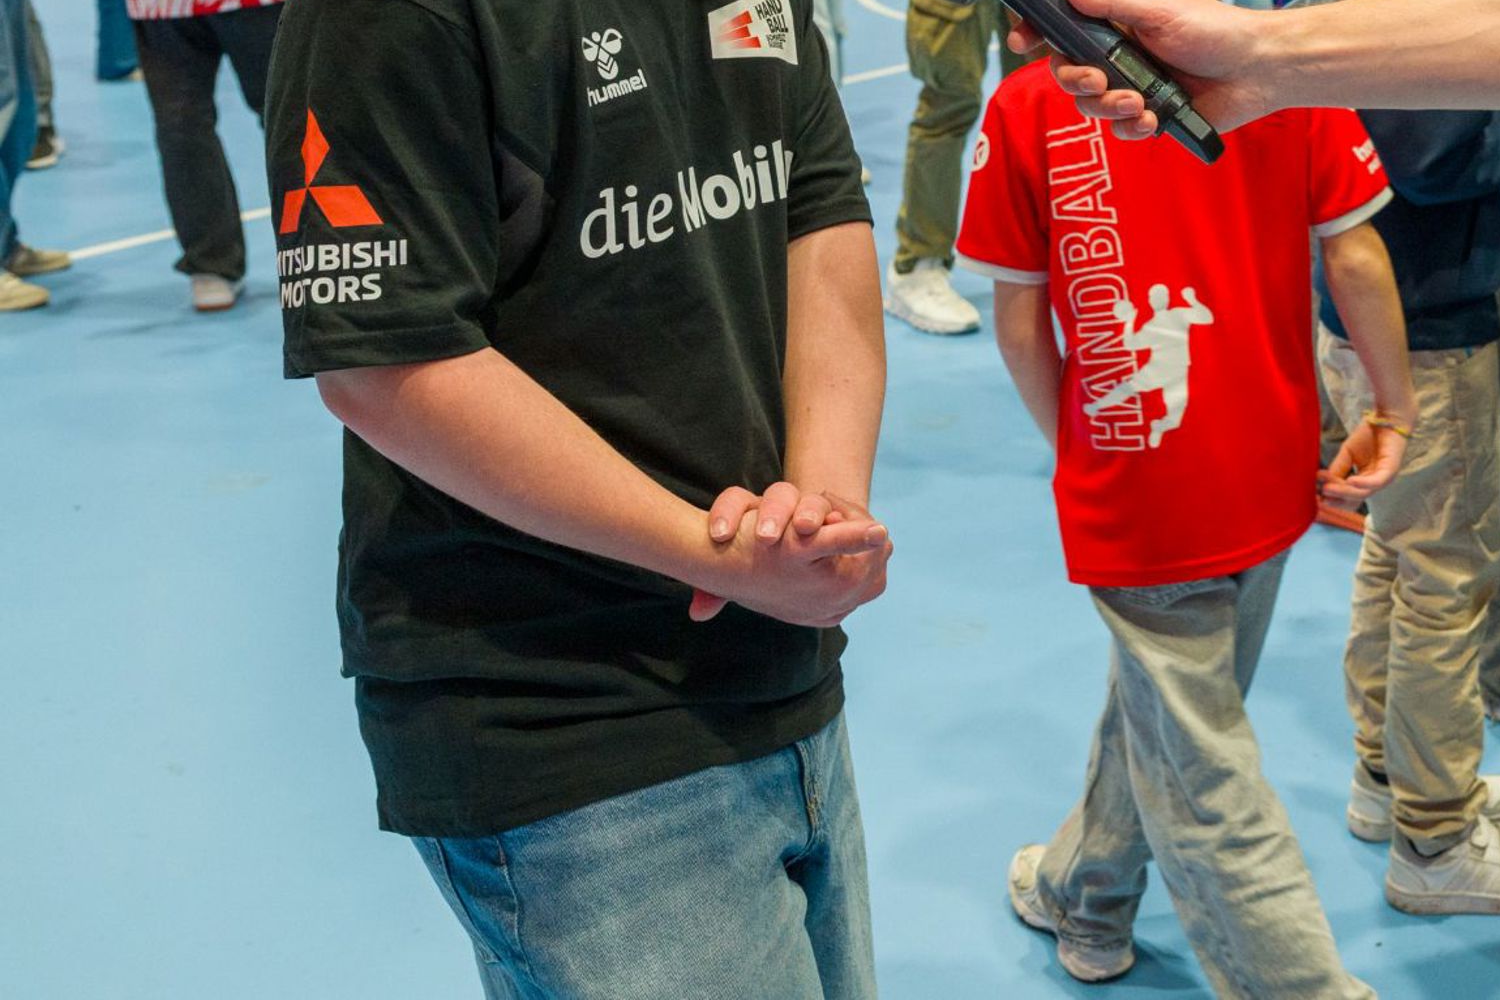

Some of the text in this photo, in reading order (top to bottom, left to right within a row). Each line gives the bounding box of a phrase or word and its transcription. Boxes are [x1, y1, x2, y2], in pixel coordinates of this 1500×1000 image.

[766, 14, 789, 34] BALL
[586, 68, 648, 107] hummel
[281, 273, 383, 309] MOTORS
